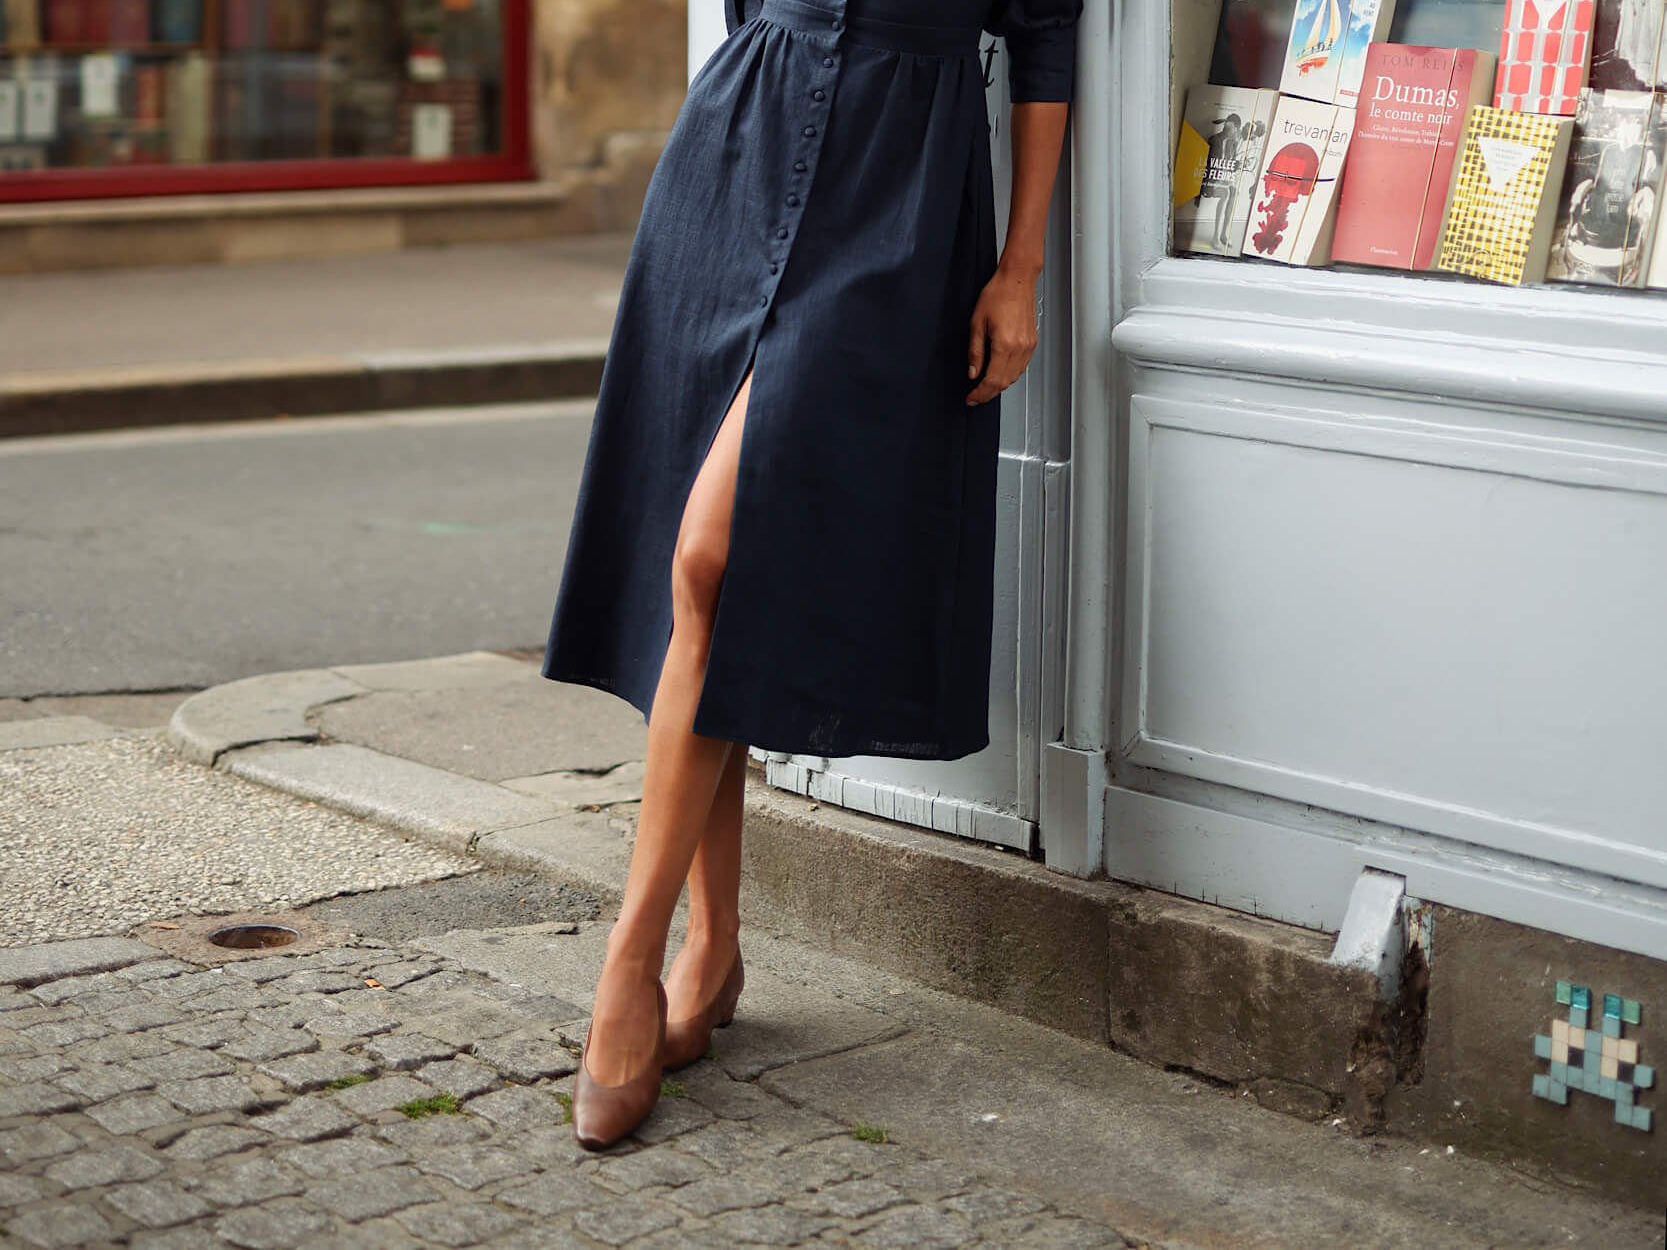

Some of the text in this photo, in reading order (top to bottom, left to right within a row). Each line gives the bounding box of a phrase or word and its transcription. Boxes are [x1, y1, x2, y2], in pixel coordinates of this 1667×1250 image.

[1382, 54, 1415, 68] TOM
[1372, 75, 1460, 110] Dumas,
[1369, 102, 1382, 119] le
[1384, 107, 1425, 123] comte
[1283, 119, 1348, 144] trevanan
[1208, 168, 1236, 181] FLEURS
